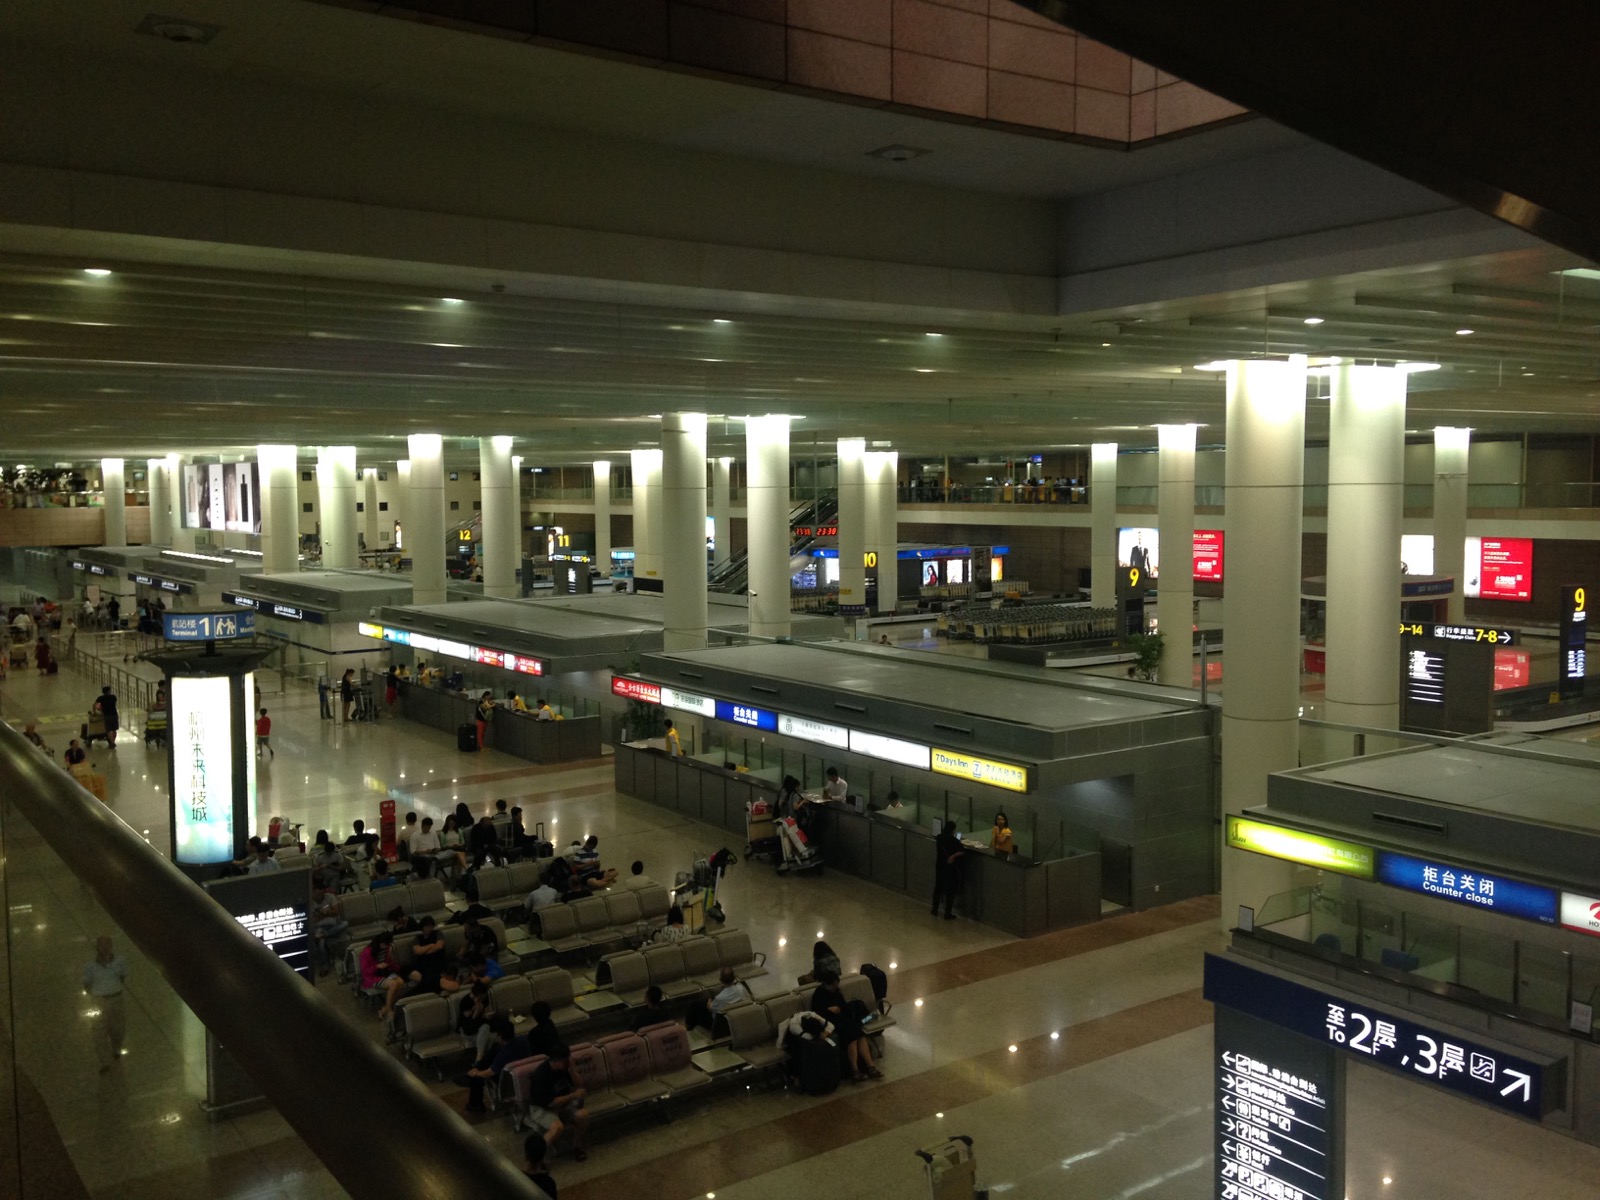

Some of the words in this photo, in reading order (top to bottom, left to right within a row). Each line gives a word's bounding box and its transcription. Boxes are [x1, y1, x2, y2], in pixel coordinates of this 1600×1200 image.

[460, 529, 471, 540] 12
[558, 534, 570, 547] 11
[864, 552, 876, 568] 10
[1130, 568, 1139, 587] 9
[1574, 588, 1585, 612] 9
[199, 617, 209, 636] 1
[1475, 628, 1498, 643] 7-8
[1423, 865, 1494, 896] 柜台关闭
[1423, 881, 1463, 898] Counter
[1465, 891, 1494, 906] close
